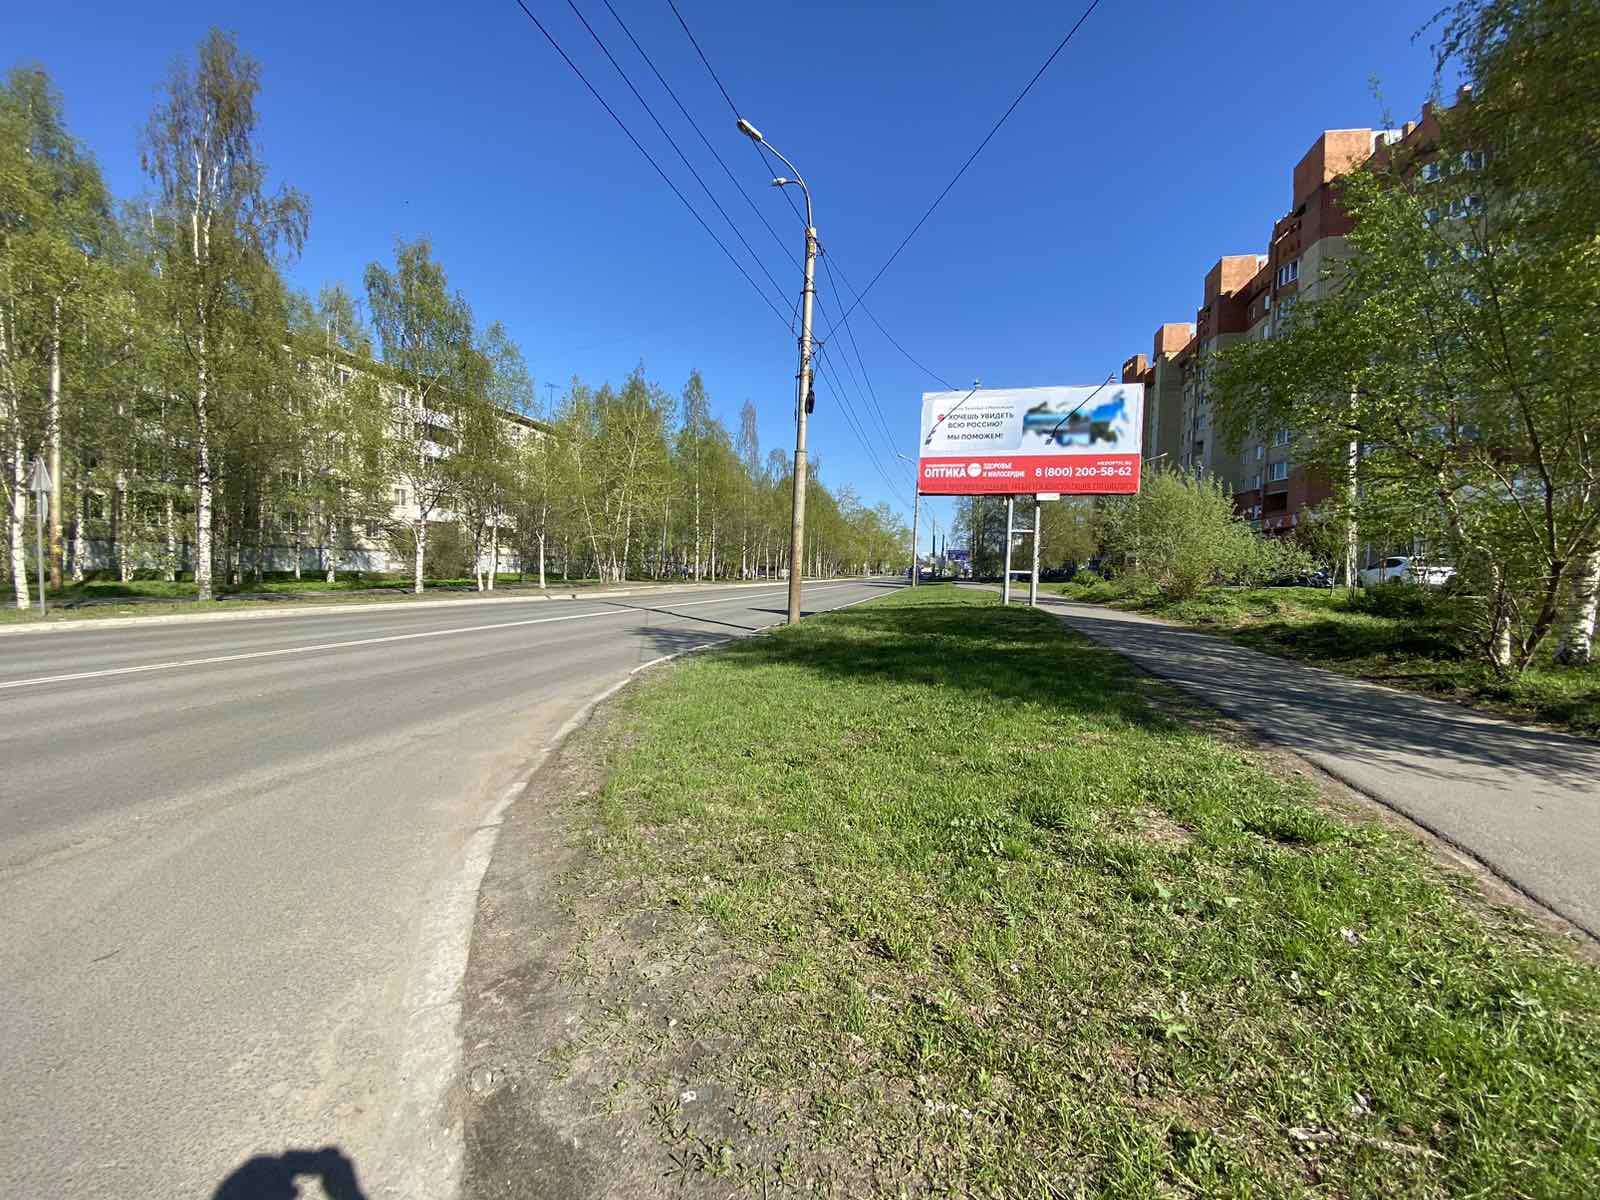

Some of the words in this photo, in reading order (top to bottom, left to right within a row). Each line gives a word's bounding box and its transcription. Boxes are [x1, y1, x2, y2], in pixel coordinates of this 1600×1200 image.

[966, 420, 1003, 428] РОССИЮ?
[961, 432, 1004, 440] ПОМОЖЕМ!
[925, 468, 967, 478] ОПТИКА
[1035, 467, 1042, 477] 8
[1044, 466, 1073, 478] (800)
[1075, 466, 1132, 477] 200-58-62
